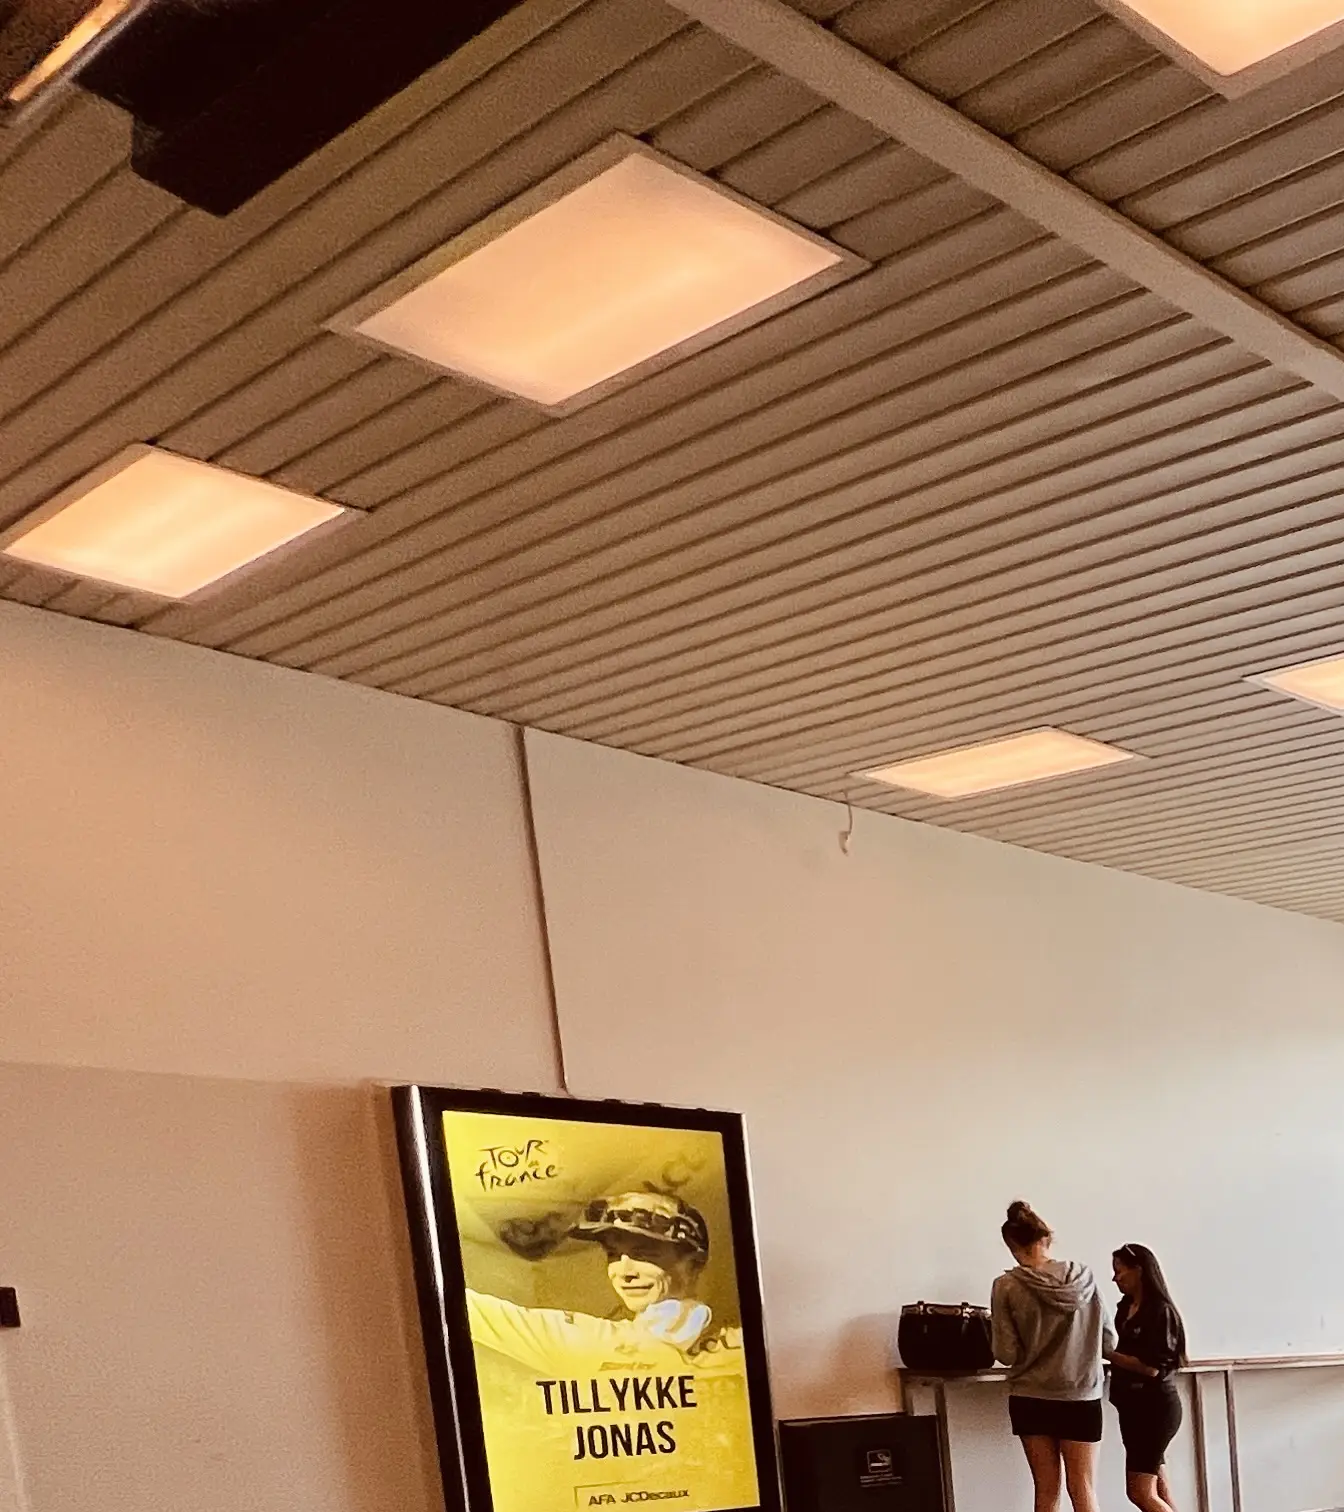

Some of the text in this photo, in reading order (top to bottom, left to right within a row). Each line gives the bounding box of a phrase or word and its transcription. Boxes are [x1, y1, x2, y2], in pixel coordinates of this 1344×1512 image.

[535, 1374, 698, 1415] TILLYKKE
[573, 1420, 677, 1461] JONAS
[588, 1488, 690, 1507] AFA JCDecaux
